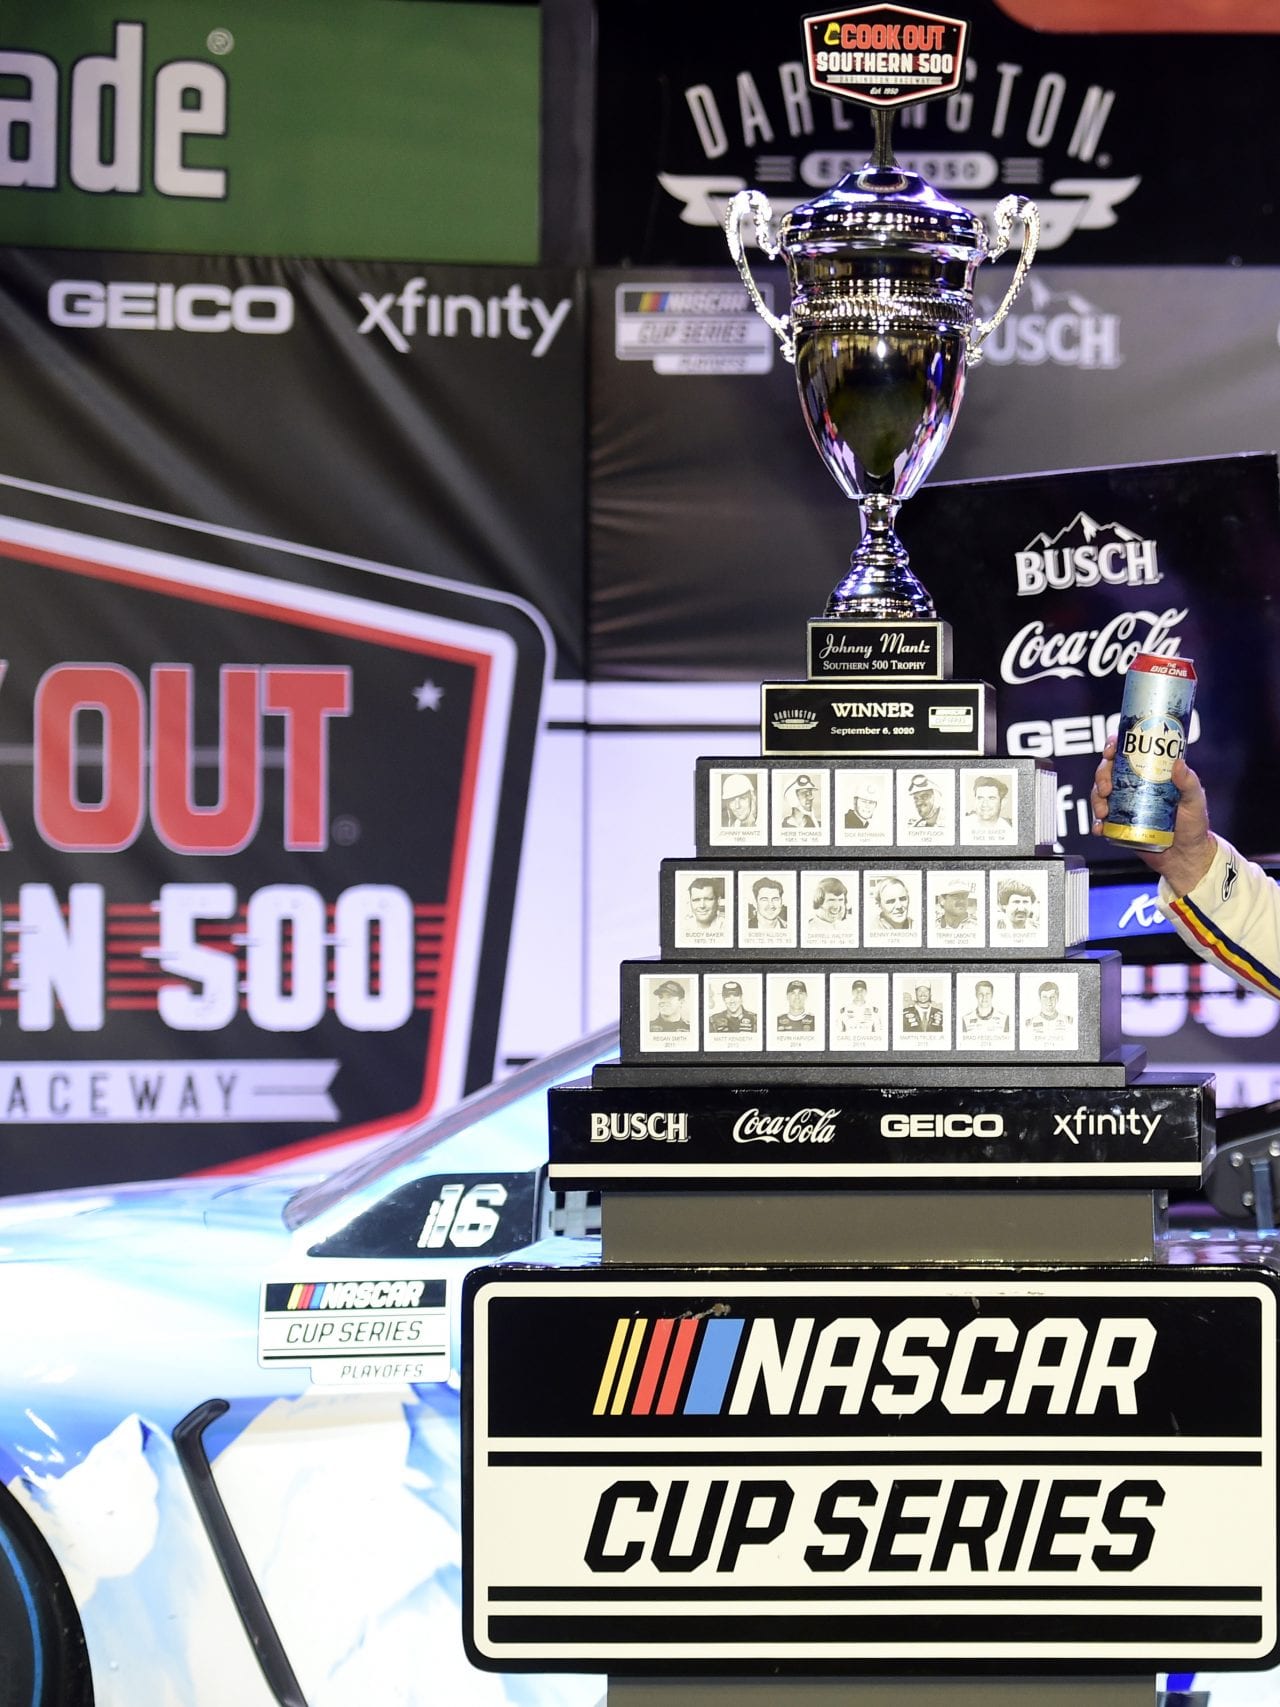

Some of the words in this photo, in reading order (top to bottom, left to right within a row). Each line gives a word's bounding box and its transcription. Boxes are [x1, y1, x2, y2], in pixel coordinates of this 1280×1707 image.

[841, 24, 900, 49] COOK
[903, 25, 945, 50] OUT
[816, 52, 913, 73] SOUTHERN
[918, 54, 953, 73] 500
[48, 280, 294, 334] GEICO
[358, 277, 571, 357] xfinity
[970, 315, 1122, 369] USCH
[1015, 540, 1160, 597] BUSCH
[819, 633, 873, 659] Johnny
[880, 633, 930, 654] Mantz
[823, 660, 869, 670] SOUTHERN
[871, 660, 889, 670] 500
[890, 660, 926, 671] TROPHY
[1150, 666, 1168, 675] BIG
[1168, 669, 1188, 677] ONE
[831, 702, 914, 718] WINNER
[830, 727, 880, 736] September
[882, 727, 891, 736] 6,
[893, 727, 915, 735] 2020
[1124, 732, 1186, 759] BUSCH
[33, 662, 353, 856] OUT
[155, 883, 415, 1032] 500
[590, 1112, 689, 1143] BUSCH
[880, 1113, 1005, 1138] GEICO
[1053, 1106, 1161, 1144] xfinity
[416, 1183, 508, 1248] 16
[320, 1280, 425, 1310] NASCAR
[286, 1322, 334, 1343] CUP
[338, 1320, 422, 1343] SERIES
[341, 1363, 424, 1379] PLAYOFFS
[728, 1317, 1158, 1415] NASCAR
[584, 1479, 796, 1573] CUP
[803, 1479, 1166, 1573] SERIES
